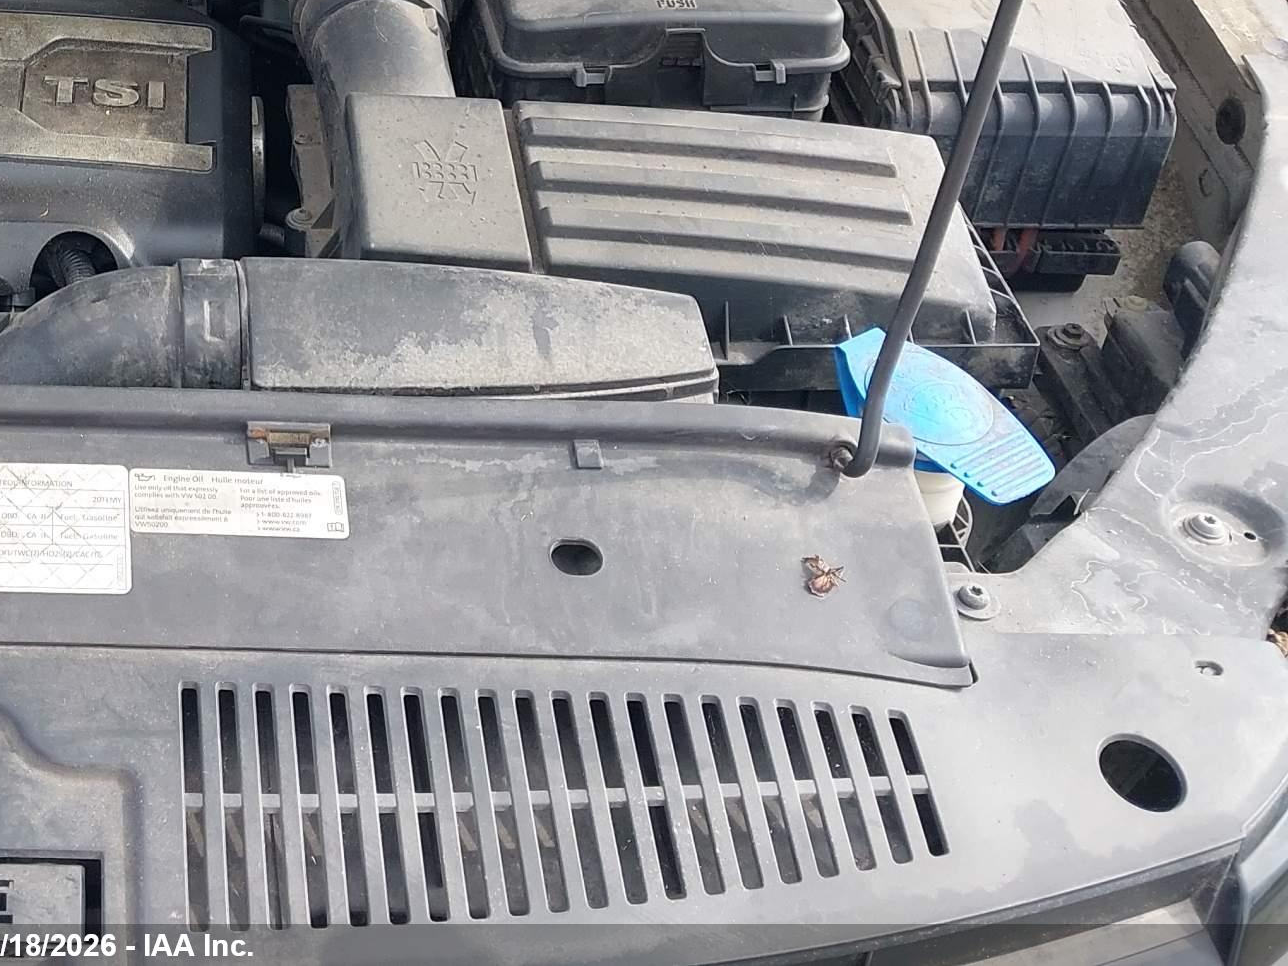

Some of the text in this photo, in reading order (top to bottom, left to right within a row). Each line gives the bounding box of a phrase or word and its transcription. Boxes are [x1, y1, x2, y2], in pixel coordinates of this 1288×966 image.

[655, 0, 697, 9] PUSH
[42, 75, 167, 109] TSI
[163, 474, 191, 484] Engine
[191, 474, 204, 483] Oil
[234, 477, 264, 485] moteur
